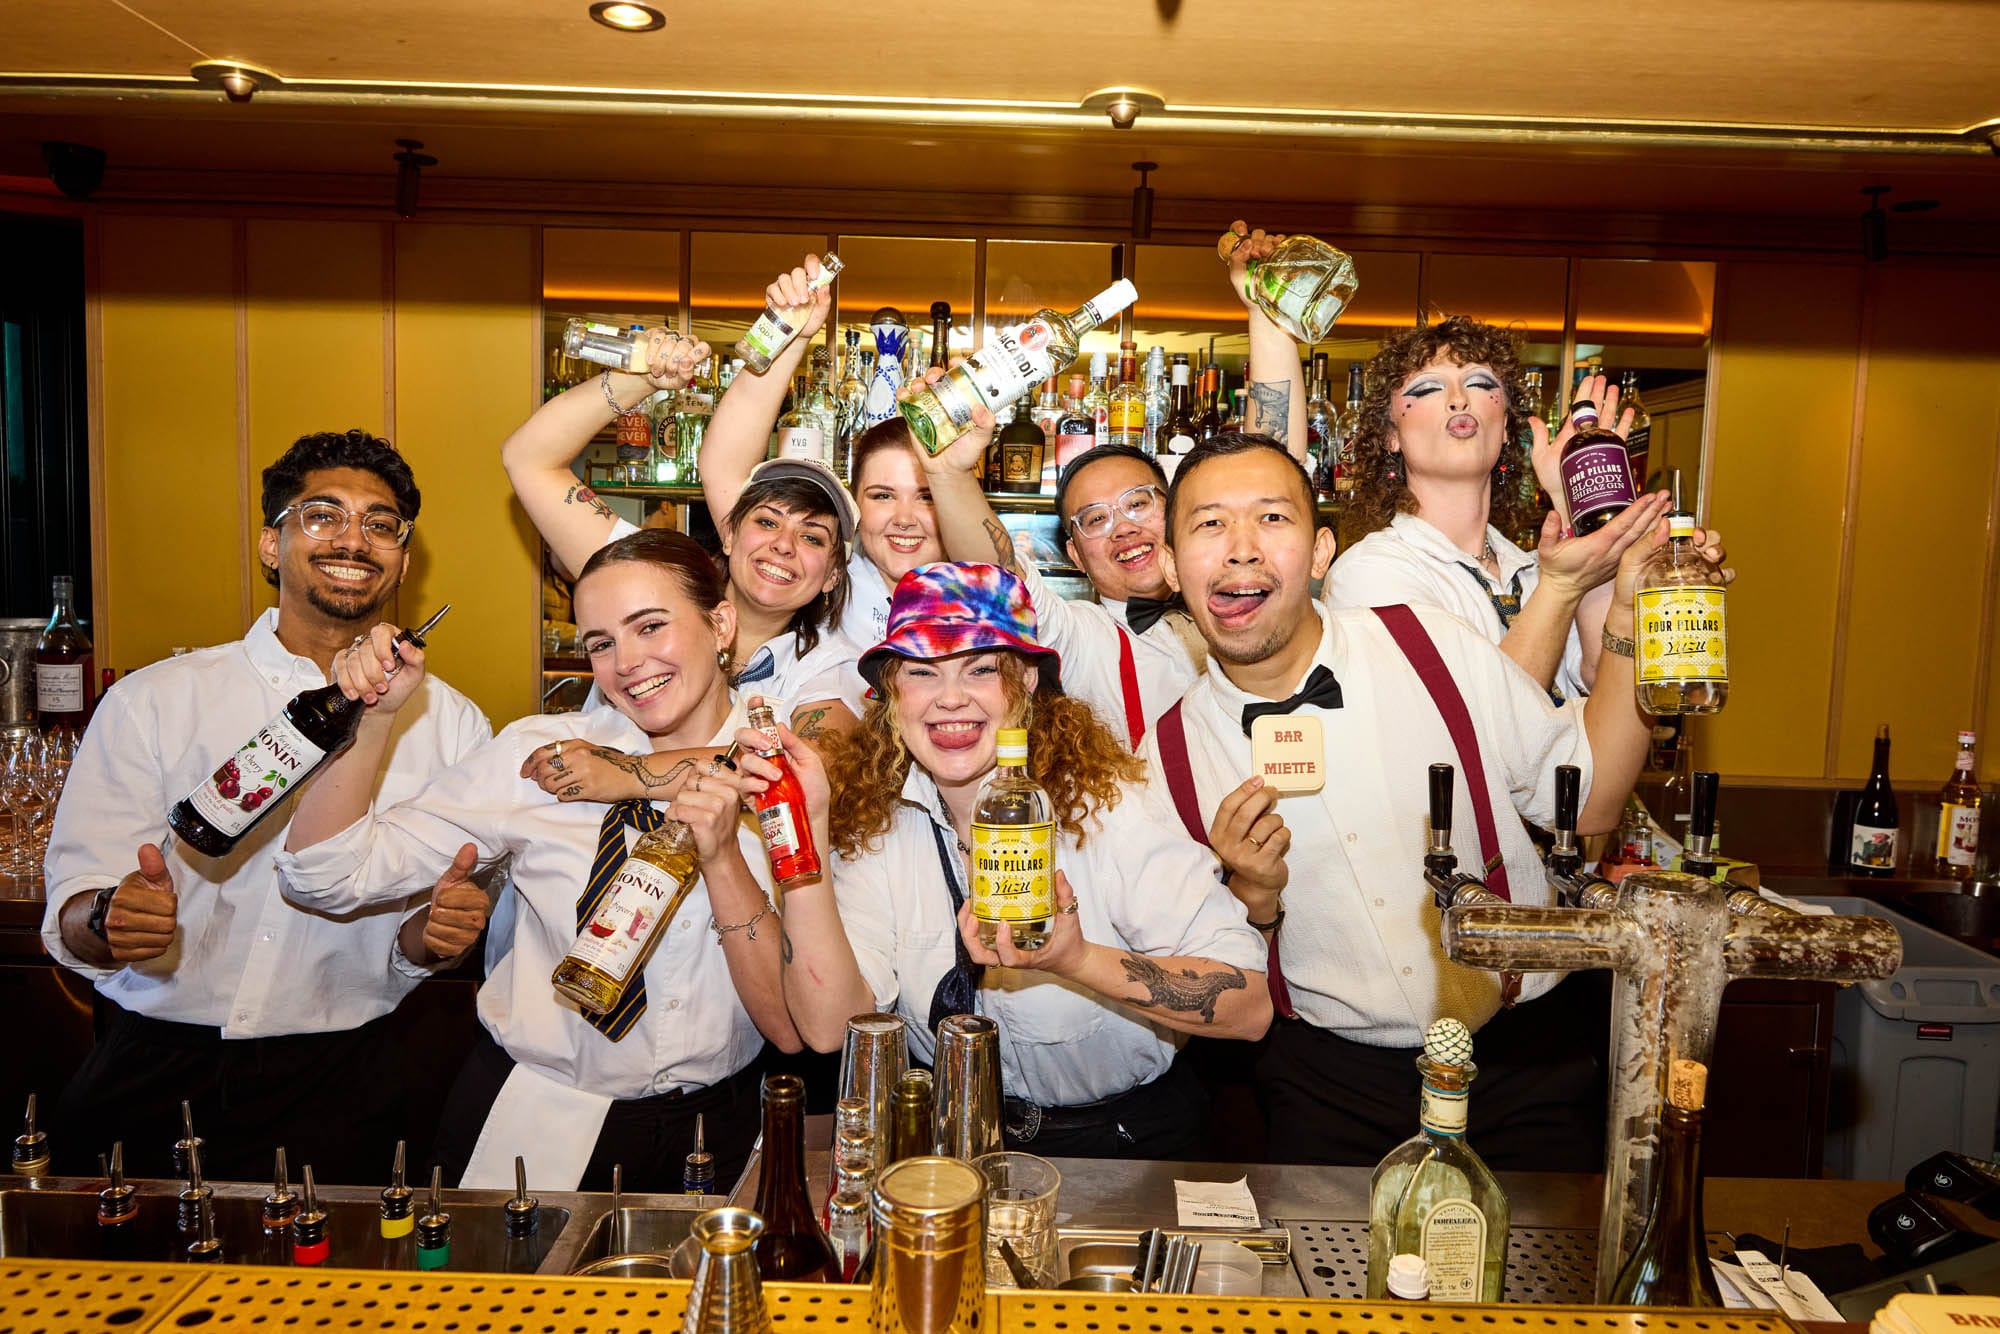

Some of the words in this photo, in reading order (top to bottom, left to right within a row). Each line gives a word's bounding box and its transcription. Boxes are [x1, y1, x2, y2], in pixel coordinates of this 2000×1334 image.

[1109, 405, 1140, 413] BAROL
[1569, 471, 1585, 486] FOUR
[1587, 464, 1622, 476] PILLARS
[1572, 474, 1623, 495] BLOODY
[1573, 484, 1605, 501] SHIRAZ
[1649, 620, 1672, 632] FOUR
[1677, 619, 1719, 632] PILLARS
[1274, 730, 1303, 742] BAR
[1264, 762, 1316, 775] MIETTE
[979, 857, 1000, 871] FOUR
[1004, 858, 1043, 872] PILLARS
[994, 880, 1031, 893] Yuzu
